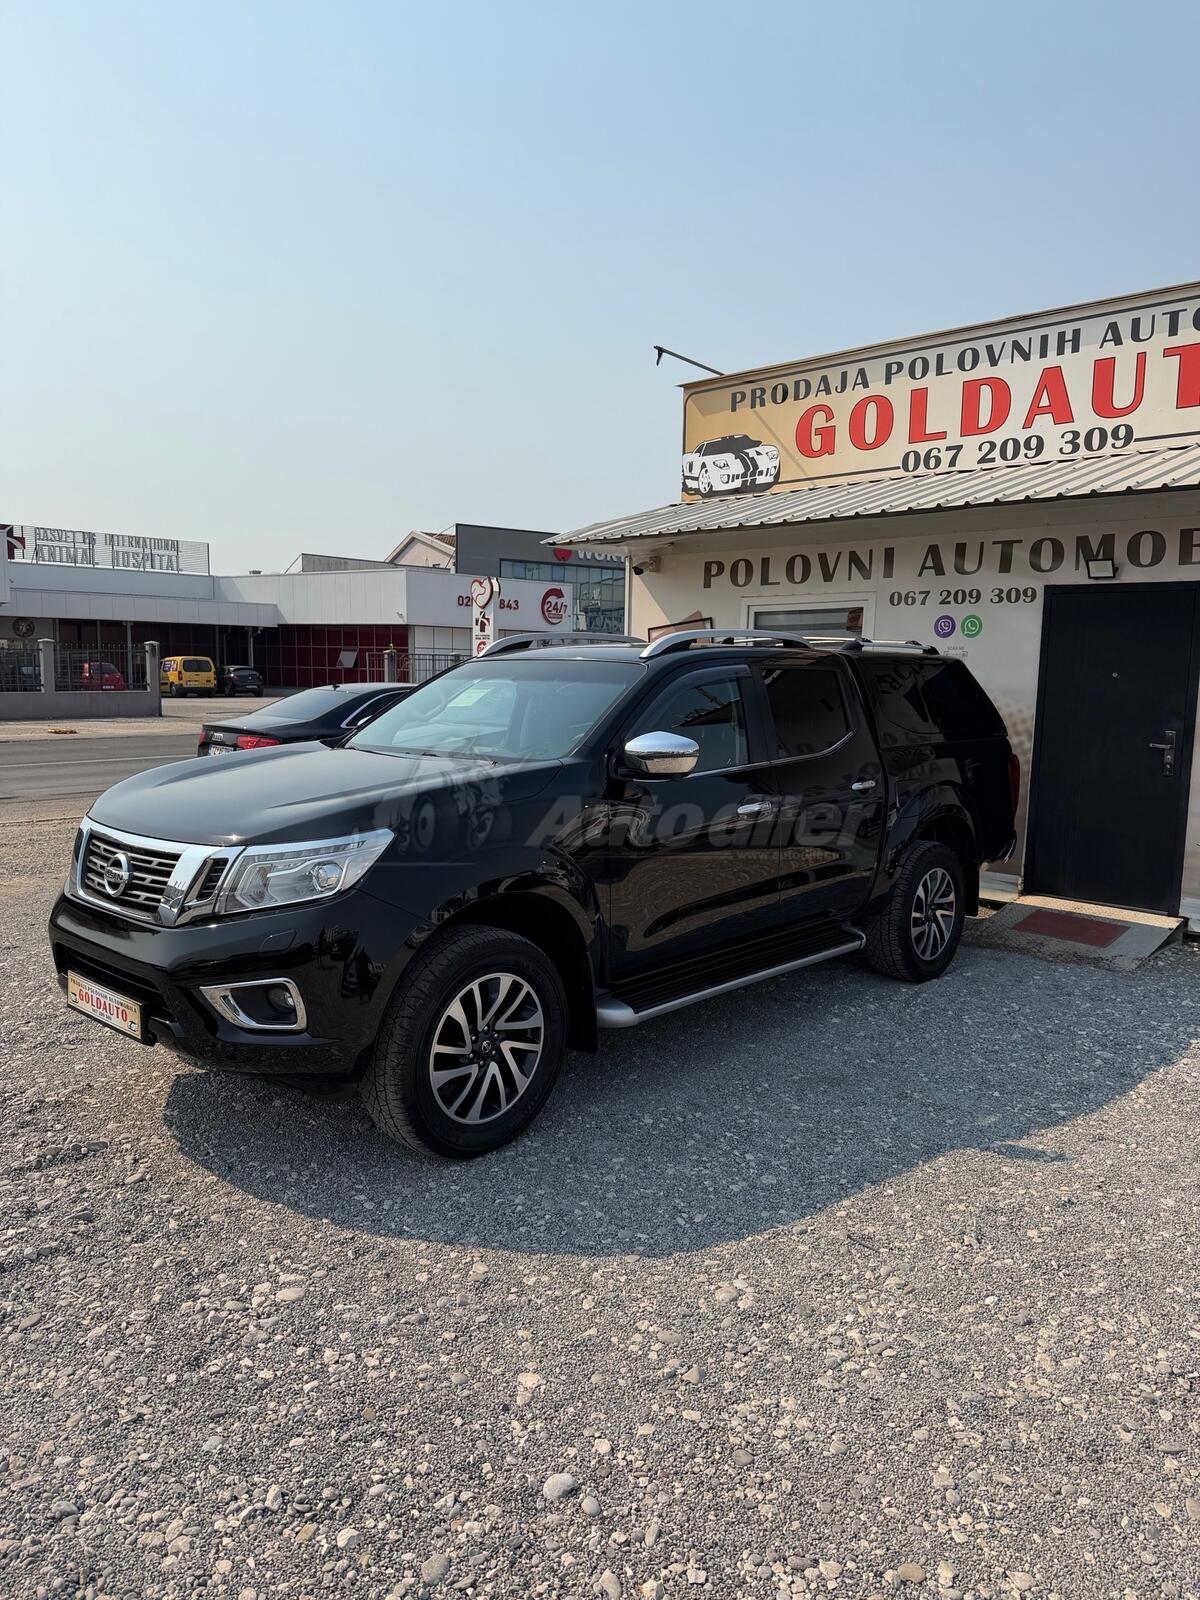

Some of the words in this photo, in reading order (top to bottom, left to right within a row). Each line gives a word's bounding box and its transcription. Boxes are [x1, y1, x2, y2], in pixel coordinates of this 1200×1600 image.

[730, 367, 870, 412] PRODAJA
[884, 328, 1081, 385] POLOVNIH
[901, 444, 963, 473] 067
[977, 434, 1045, 464] 209
[1059, 423, 1135, 455] 309
[37, 544, 99, 565] ANIMAL
[113, 550, 184, 571] HOSPITAL
[703, 547, 895, 589] POLOVNI
[499, 599, 519, 610] 843
[546, 600, 568, 614] 24/7
[889, 590, 931, 606] 067
[938, 588, 982, 605] 209
[990, 586, 1037, 604] 309
[79, 989, 128, 1022] GOLDAUTO
